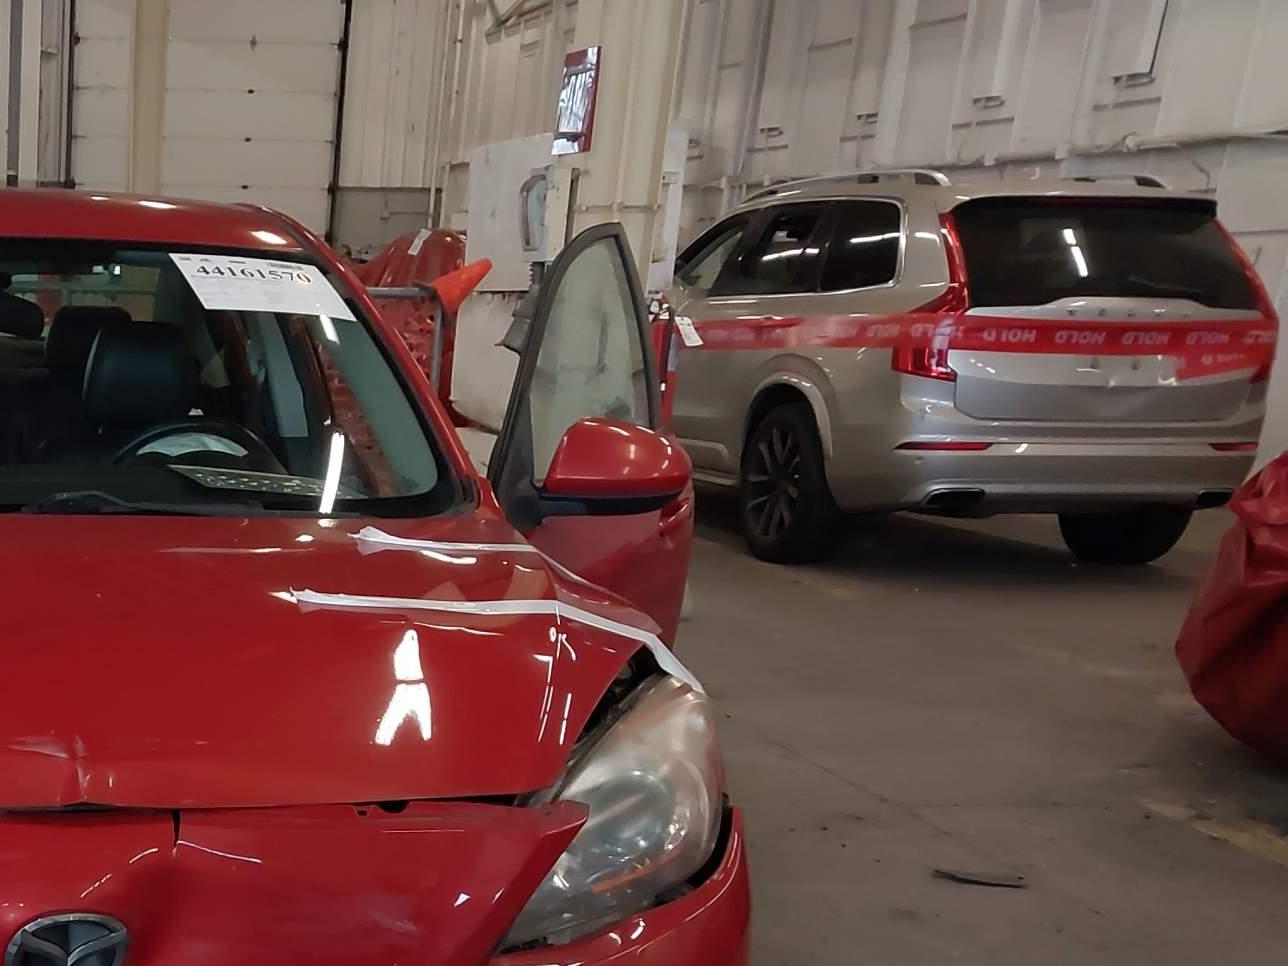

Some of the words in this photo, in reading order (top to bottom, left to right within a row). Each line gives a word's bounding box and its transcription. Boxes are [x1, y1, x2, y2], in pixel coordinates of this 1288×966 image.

[197, 265, 312, 283] 44161570
[912, 323, 963, 337] HLD
[983, 328, 1036, 343] HOLD
[1055, 329, 1106, 344] HOLD
[1122, 331, 1171, 344] HOLD
